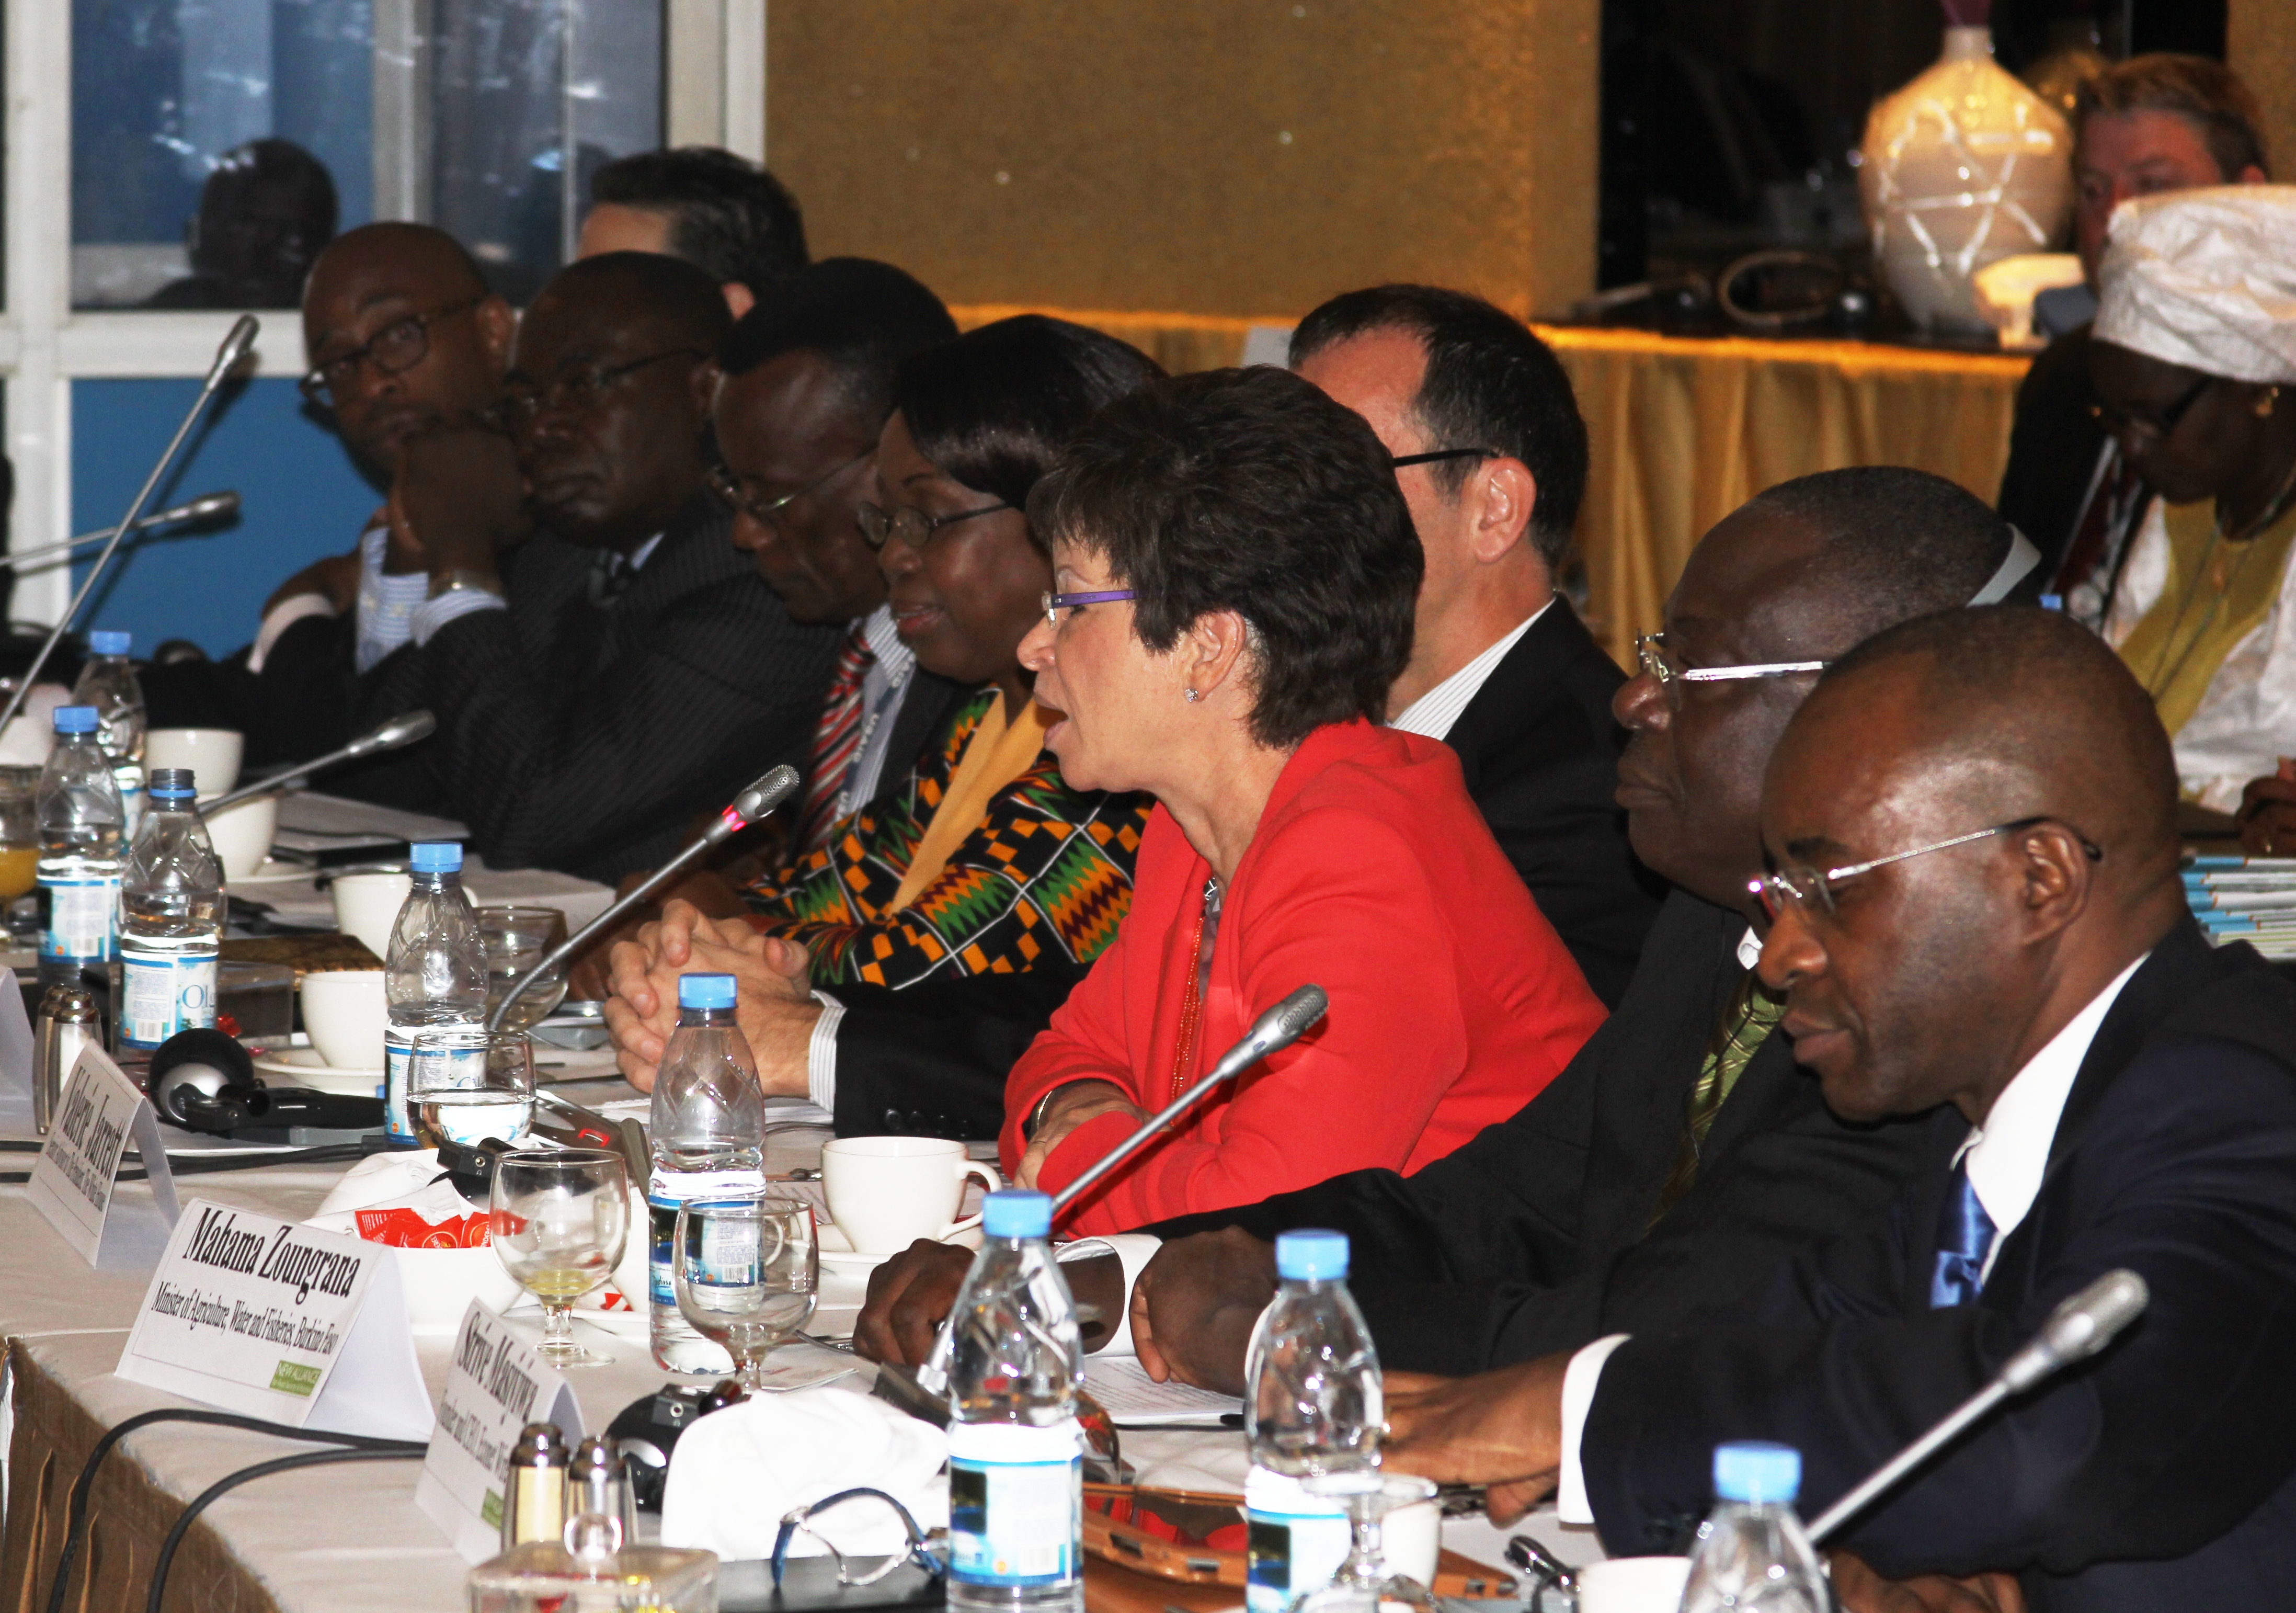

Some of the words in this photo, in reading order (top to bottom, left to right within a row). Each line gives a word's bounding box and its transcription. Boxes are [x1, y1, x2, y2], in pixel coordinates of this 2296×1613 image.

[61, 1066, 99, 1150] Valerie
[85, 1094, 125, 1180] Jarrett
[182, 1207, 265, 1275] Mahama
[258, 1225, 361, 1305] Zoungrana
[151, 1281, 185, 1316] Minister
[180, 1288, 197, 1319] of
[187, 1290, 230, 1336] Agriculture,
[229, 1300, 253, 1334] Water
[248, 1307, 269, 1338] and
[261, 1309, 295, 1352] Fisheries,
[293, 1316, 324, 1351] Burkina
[317, 1323, 339, 1355] Faso
[458, 1311, 493, 1384] Strive
[484, 1335, 539, 1425] Masiyiwa
